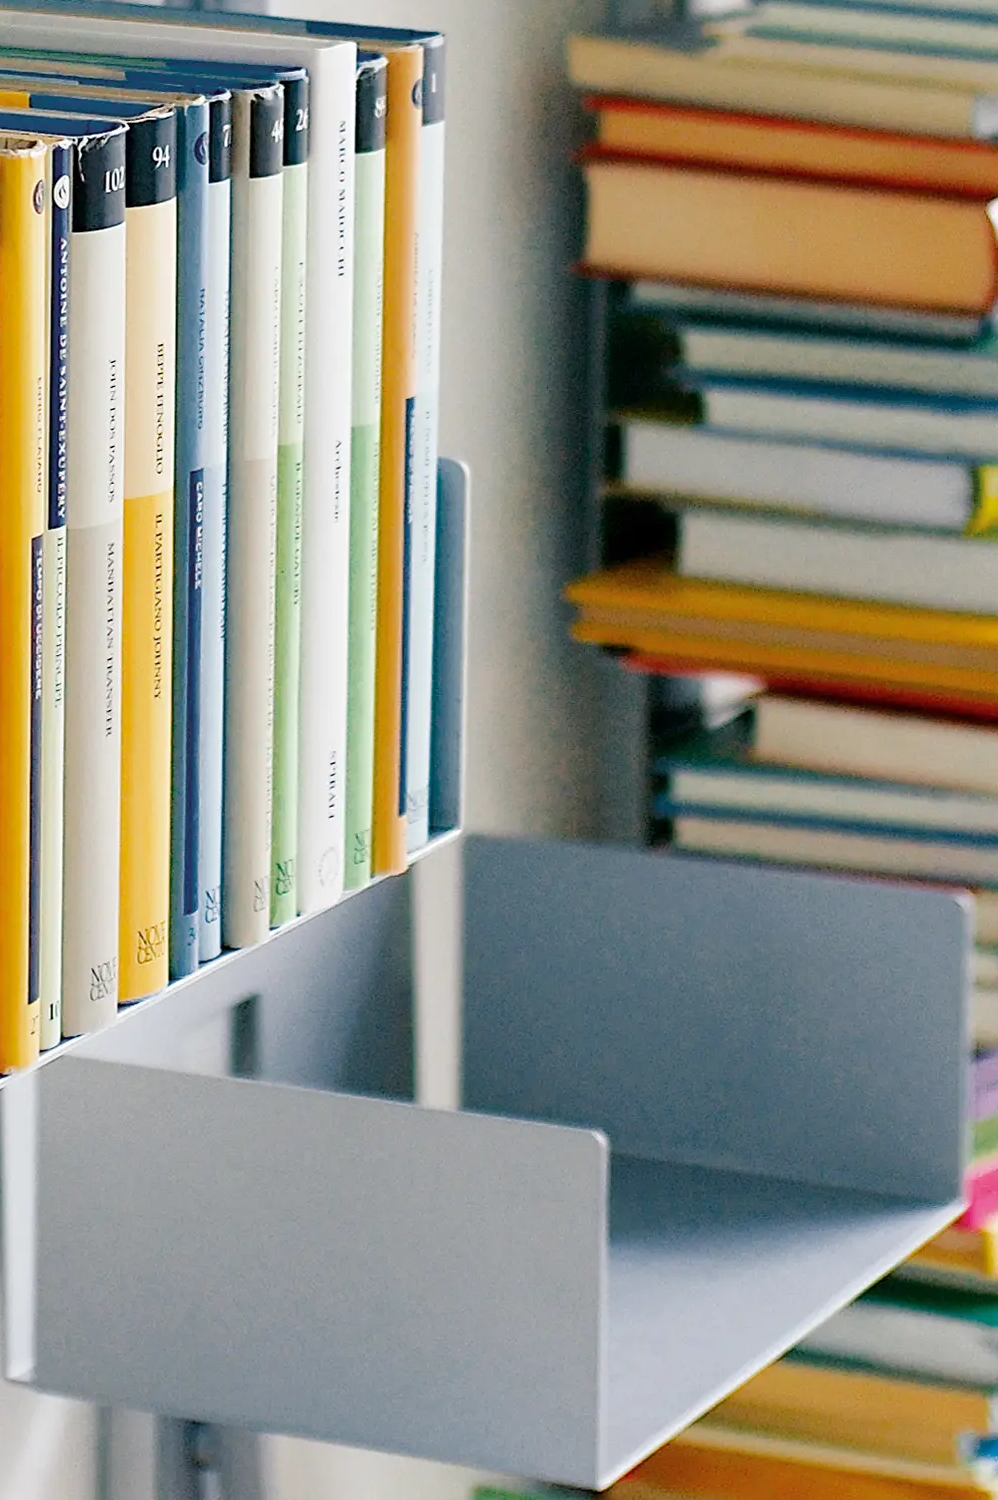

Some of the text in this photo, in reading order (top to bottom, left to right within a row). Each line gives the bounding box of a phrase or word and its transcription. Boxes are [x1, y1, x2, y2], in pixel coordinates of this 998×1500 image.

[105, 166, 125, 194] 102
[152, 144, 171, 170] 94
[338, 120, 347, 182] MARCO
[59, 237, 68, 328] ANTOINE
[58, 334, 67, 361] DE
[108, 359, 117, 401] JOHN
[155, 342, 164, 476] BEPPE FENOGLIO
[108, 445, 116, 503] PASSOS
[56, 556, 64, 629] PICCOLO
[106, 542, 115, 649] MANHATTAN
[154, 532, 163, 632] PARTIGIANO
[153, 636, 162, 700] JOHNNY
